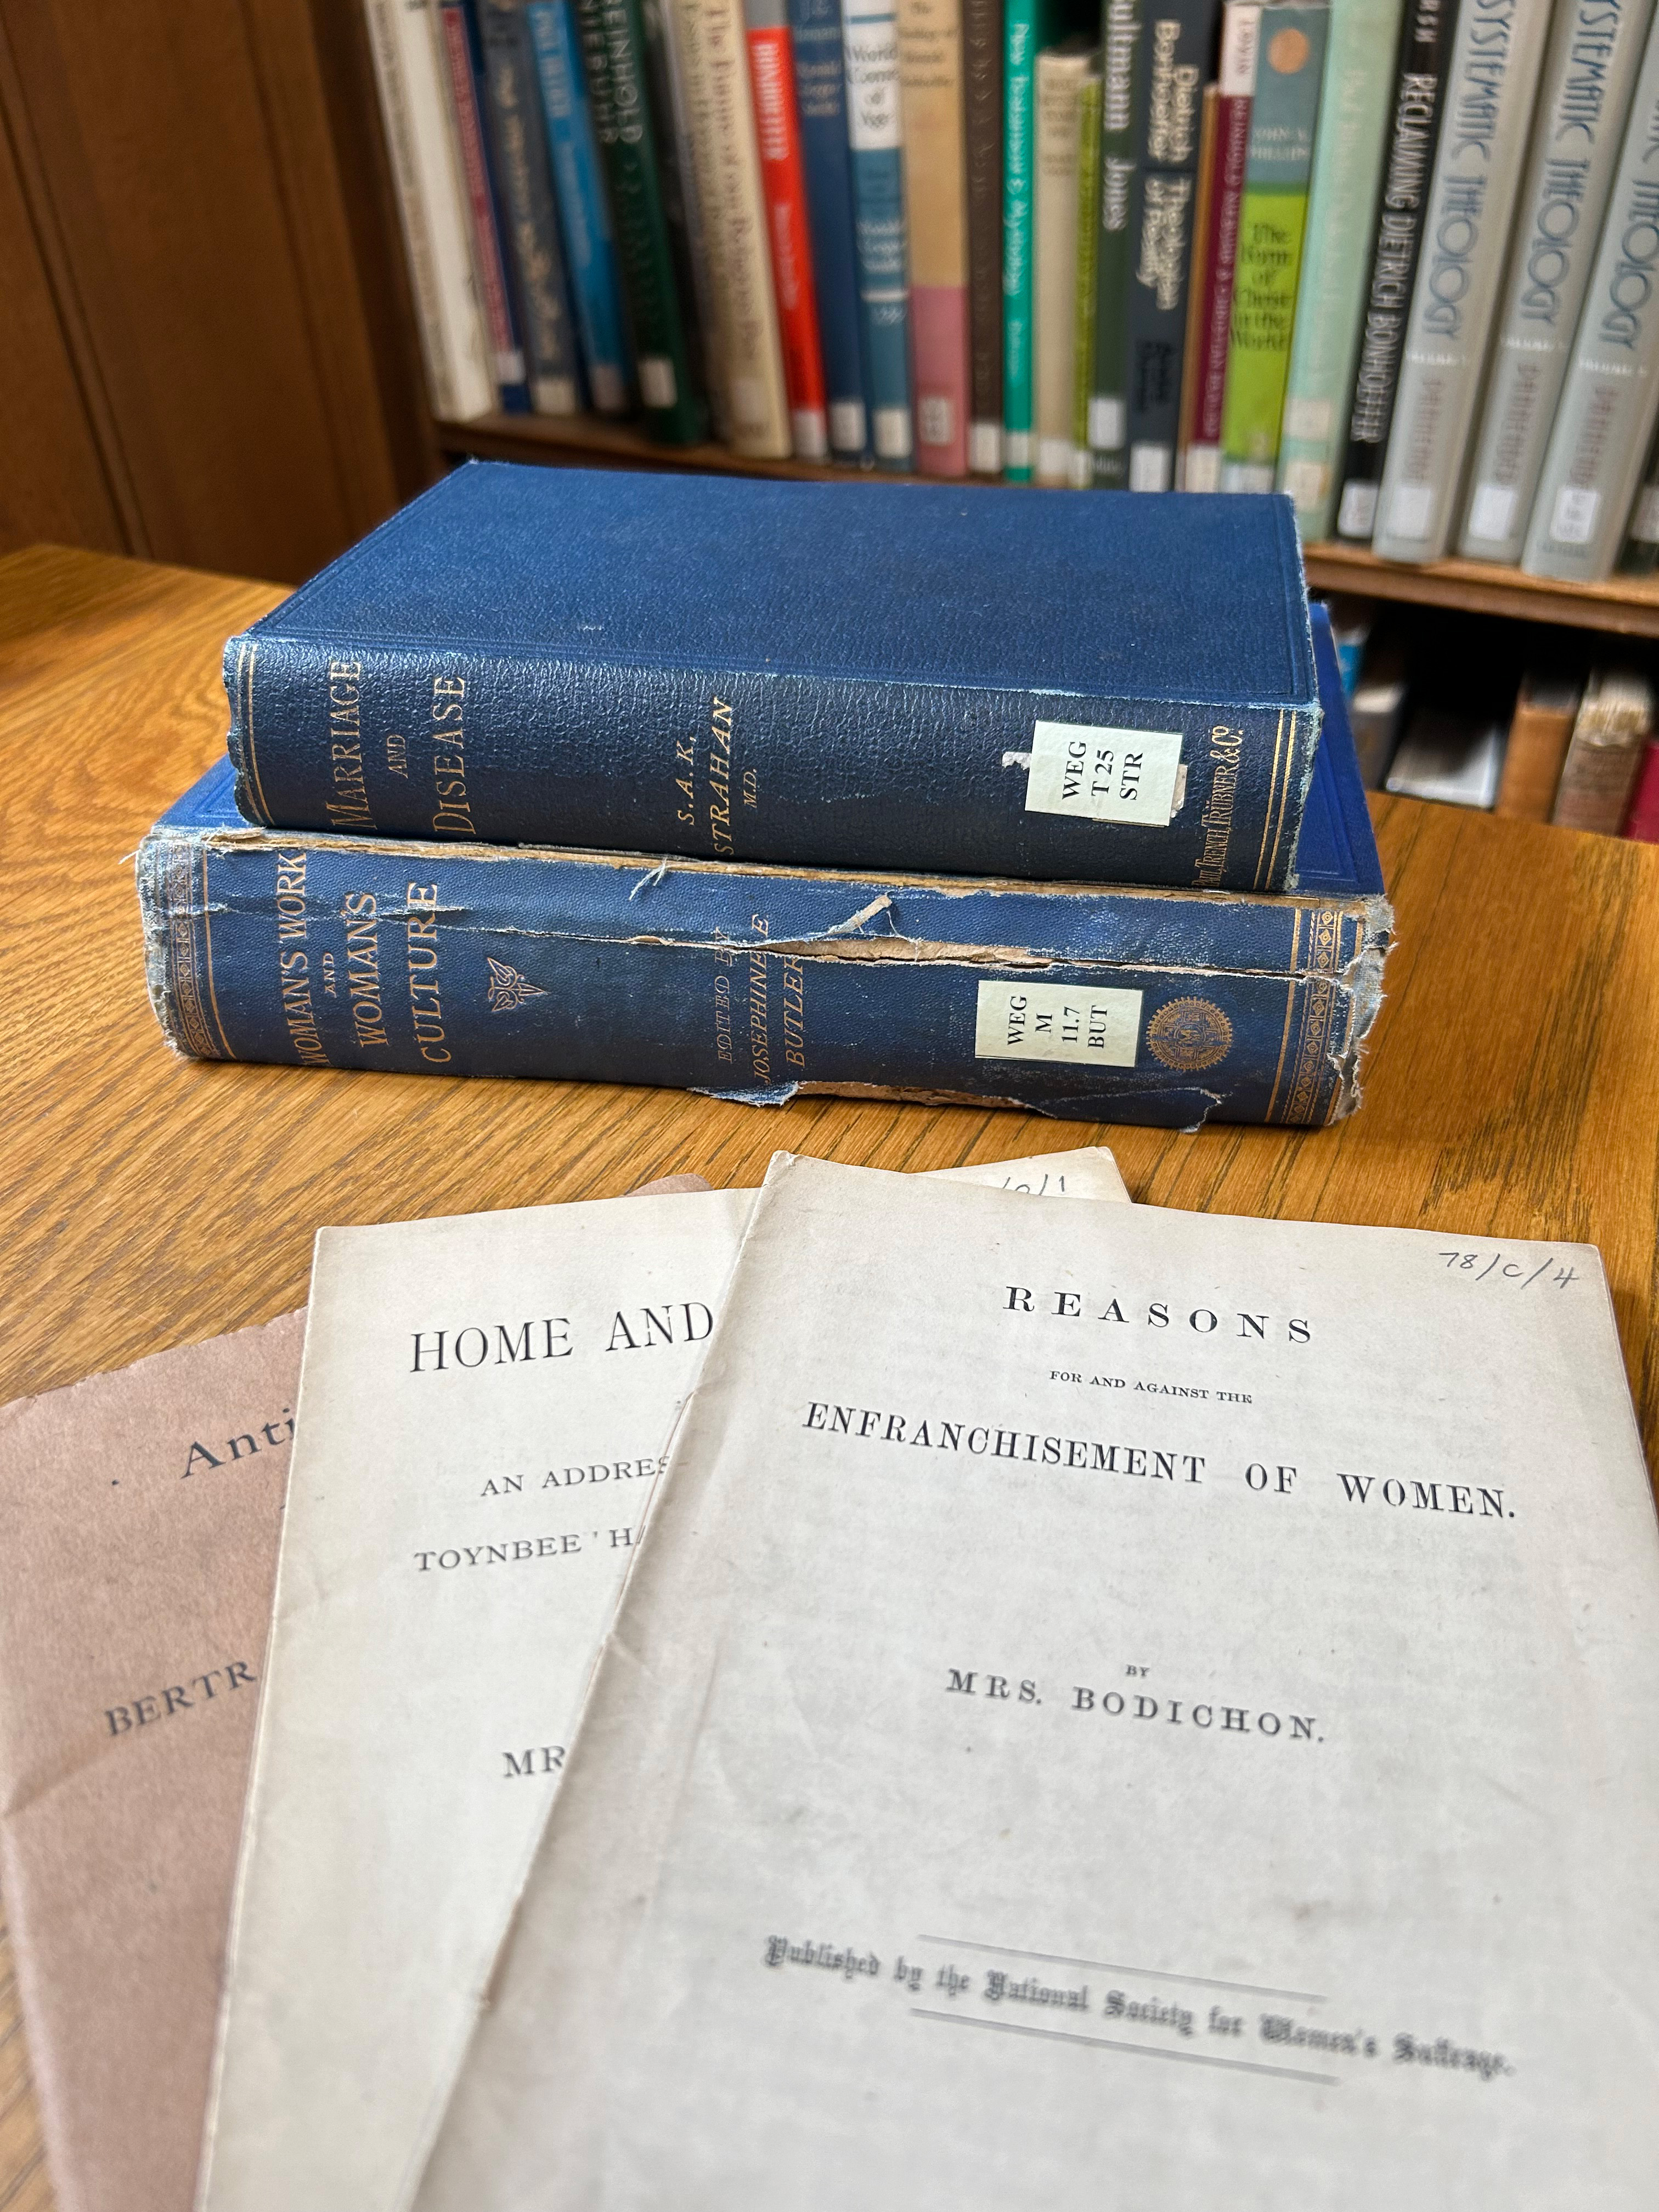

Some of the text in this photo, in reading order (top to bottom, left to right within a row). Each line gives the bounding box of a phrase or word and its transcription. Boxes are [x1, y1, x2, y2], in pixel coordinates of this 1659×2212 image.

[1102, 156, 1136, 230] Jones
[1350, 72, 1438, 443] RECLAIMING DIETRICH BONHOEFFER
[1423, 175, 1488, 340] THEOLOGY
[1520, 158, 1590, 325] THEOLOGY
[326, 661, 377, 830] MARRIAGE
[387, 734, 409, 779] AND
[432, 676, 476, 835] DISEASE
[709, 696, 734, 856] STRAHAN
[1062, 741, 1087, 800] WEG
[1091, 749, 1114, 797] T 25
[1119, 752, 1143, 801] STR
[1209, 749, 1241, 764] &
[743, 768, 757, 809] M.D.
[276, 852, 330, 1065] WOMAN'S WORK
[323, 952, 337, 998] AND
[340, 891, 390, 1048] WOMAN'S
[406, 881, 452, 1063] CULTURE
[714, 975, 733, 1063] EDITED
[1006, 995, 1027, 1046] WEG
[1035, 1013, 1053, 1034] M
[1062, 1006, 1080, 1044] 11.7
[1087, 1005, 1108, 1049] BUT
[410, 1301, 714, 1373] HOME AND
[1002, 1284, 1312, 1344] REASONS
[1049, 1370, 1252, 1404] FOR AND AGAINST THE
[480, 1474, 525, 1497] AN
[802, 1401, 1517, 1520] ENFRANCHISEMENT OF WOMEN.
[104, 1660, 258, 1737] BERTR
[1125, 1664, 1151, 1678] BY
[945, 1668, 1325, 1743] MRS. BODICHON.
[501, 1745, 566, 1779] MR
[765, 1933, 881, 1982] Published
[894, 1954, 924, 1992] by
[934, 1963, 971, 1997] the
[983, 1968, 1090, 2012] National
[1104, 1988, 1194, 2039] Society
[1207, 2004, 1243, 2038] for
